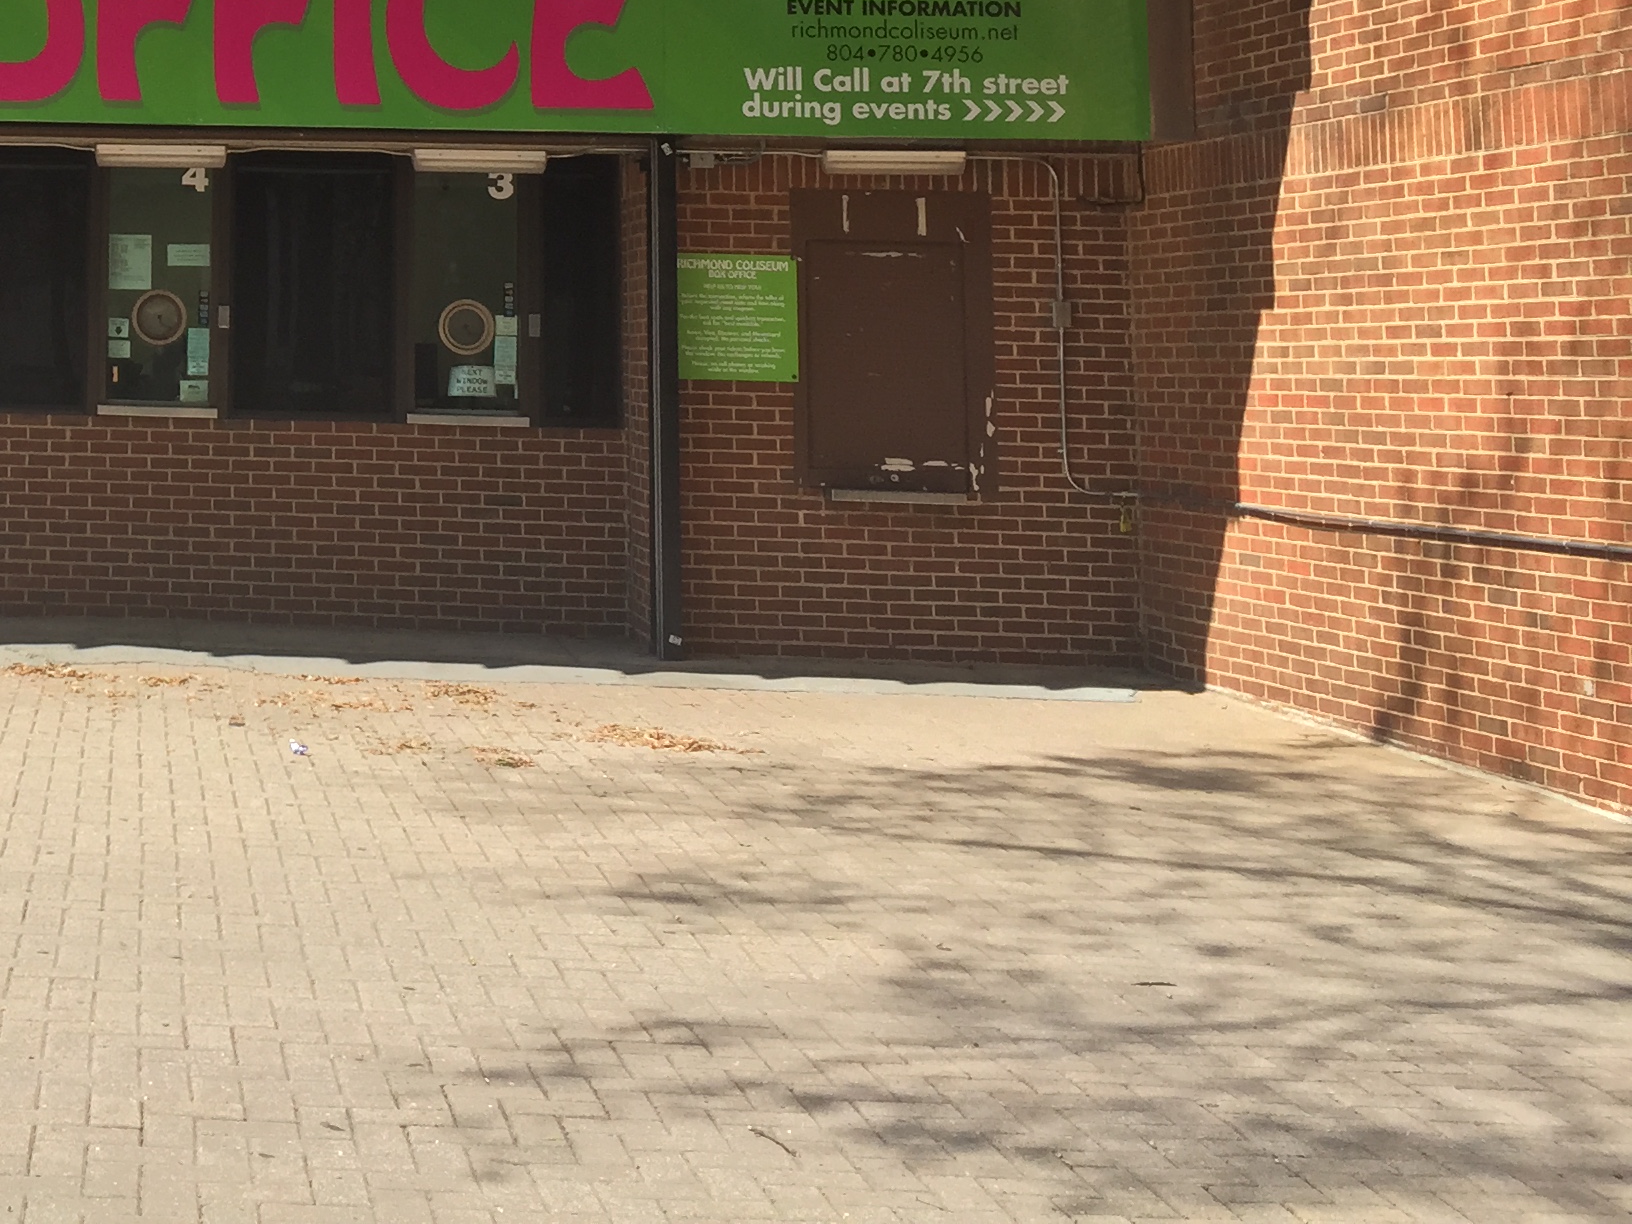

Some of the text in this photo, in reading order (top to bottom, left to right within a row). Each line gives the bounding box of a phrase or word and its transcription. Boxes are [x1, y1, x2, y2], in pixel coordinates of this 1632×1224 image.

[787, 0, 1022, 17] EVENT INFORMATION
[791, 18, 1019, 41] richmondcoliseum.net
[743, 66, 1069, 95] Will Call at 7th street
[742, 92, 952, 125] during events
[181, 167, 210, 192] 4
[487, 173, 514, 199] 3
[677, 258, 789, 272] RICHMOND COLISEUM
[728, 271, 757, 279] OFFICE
